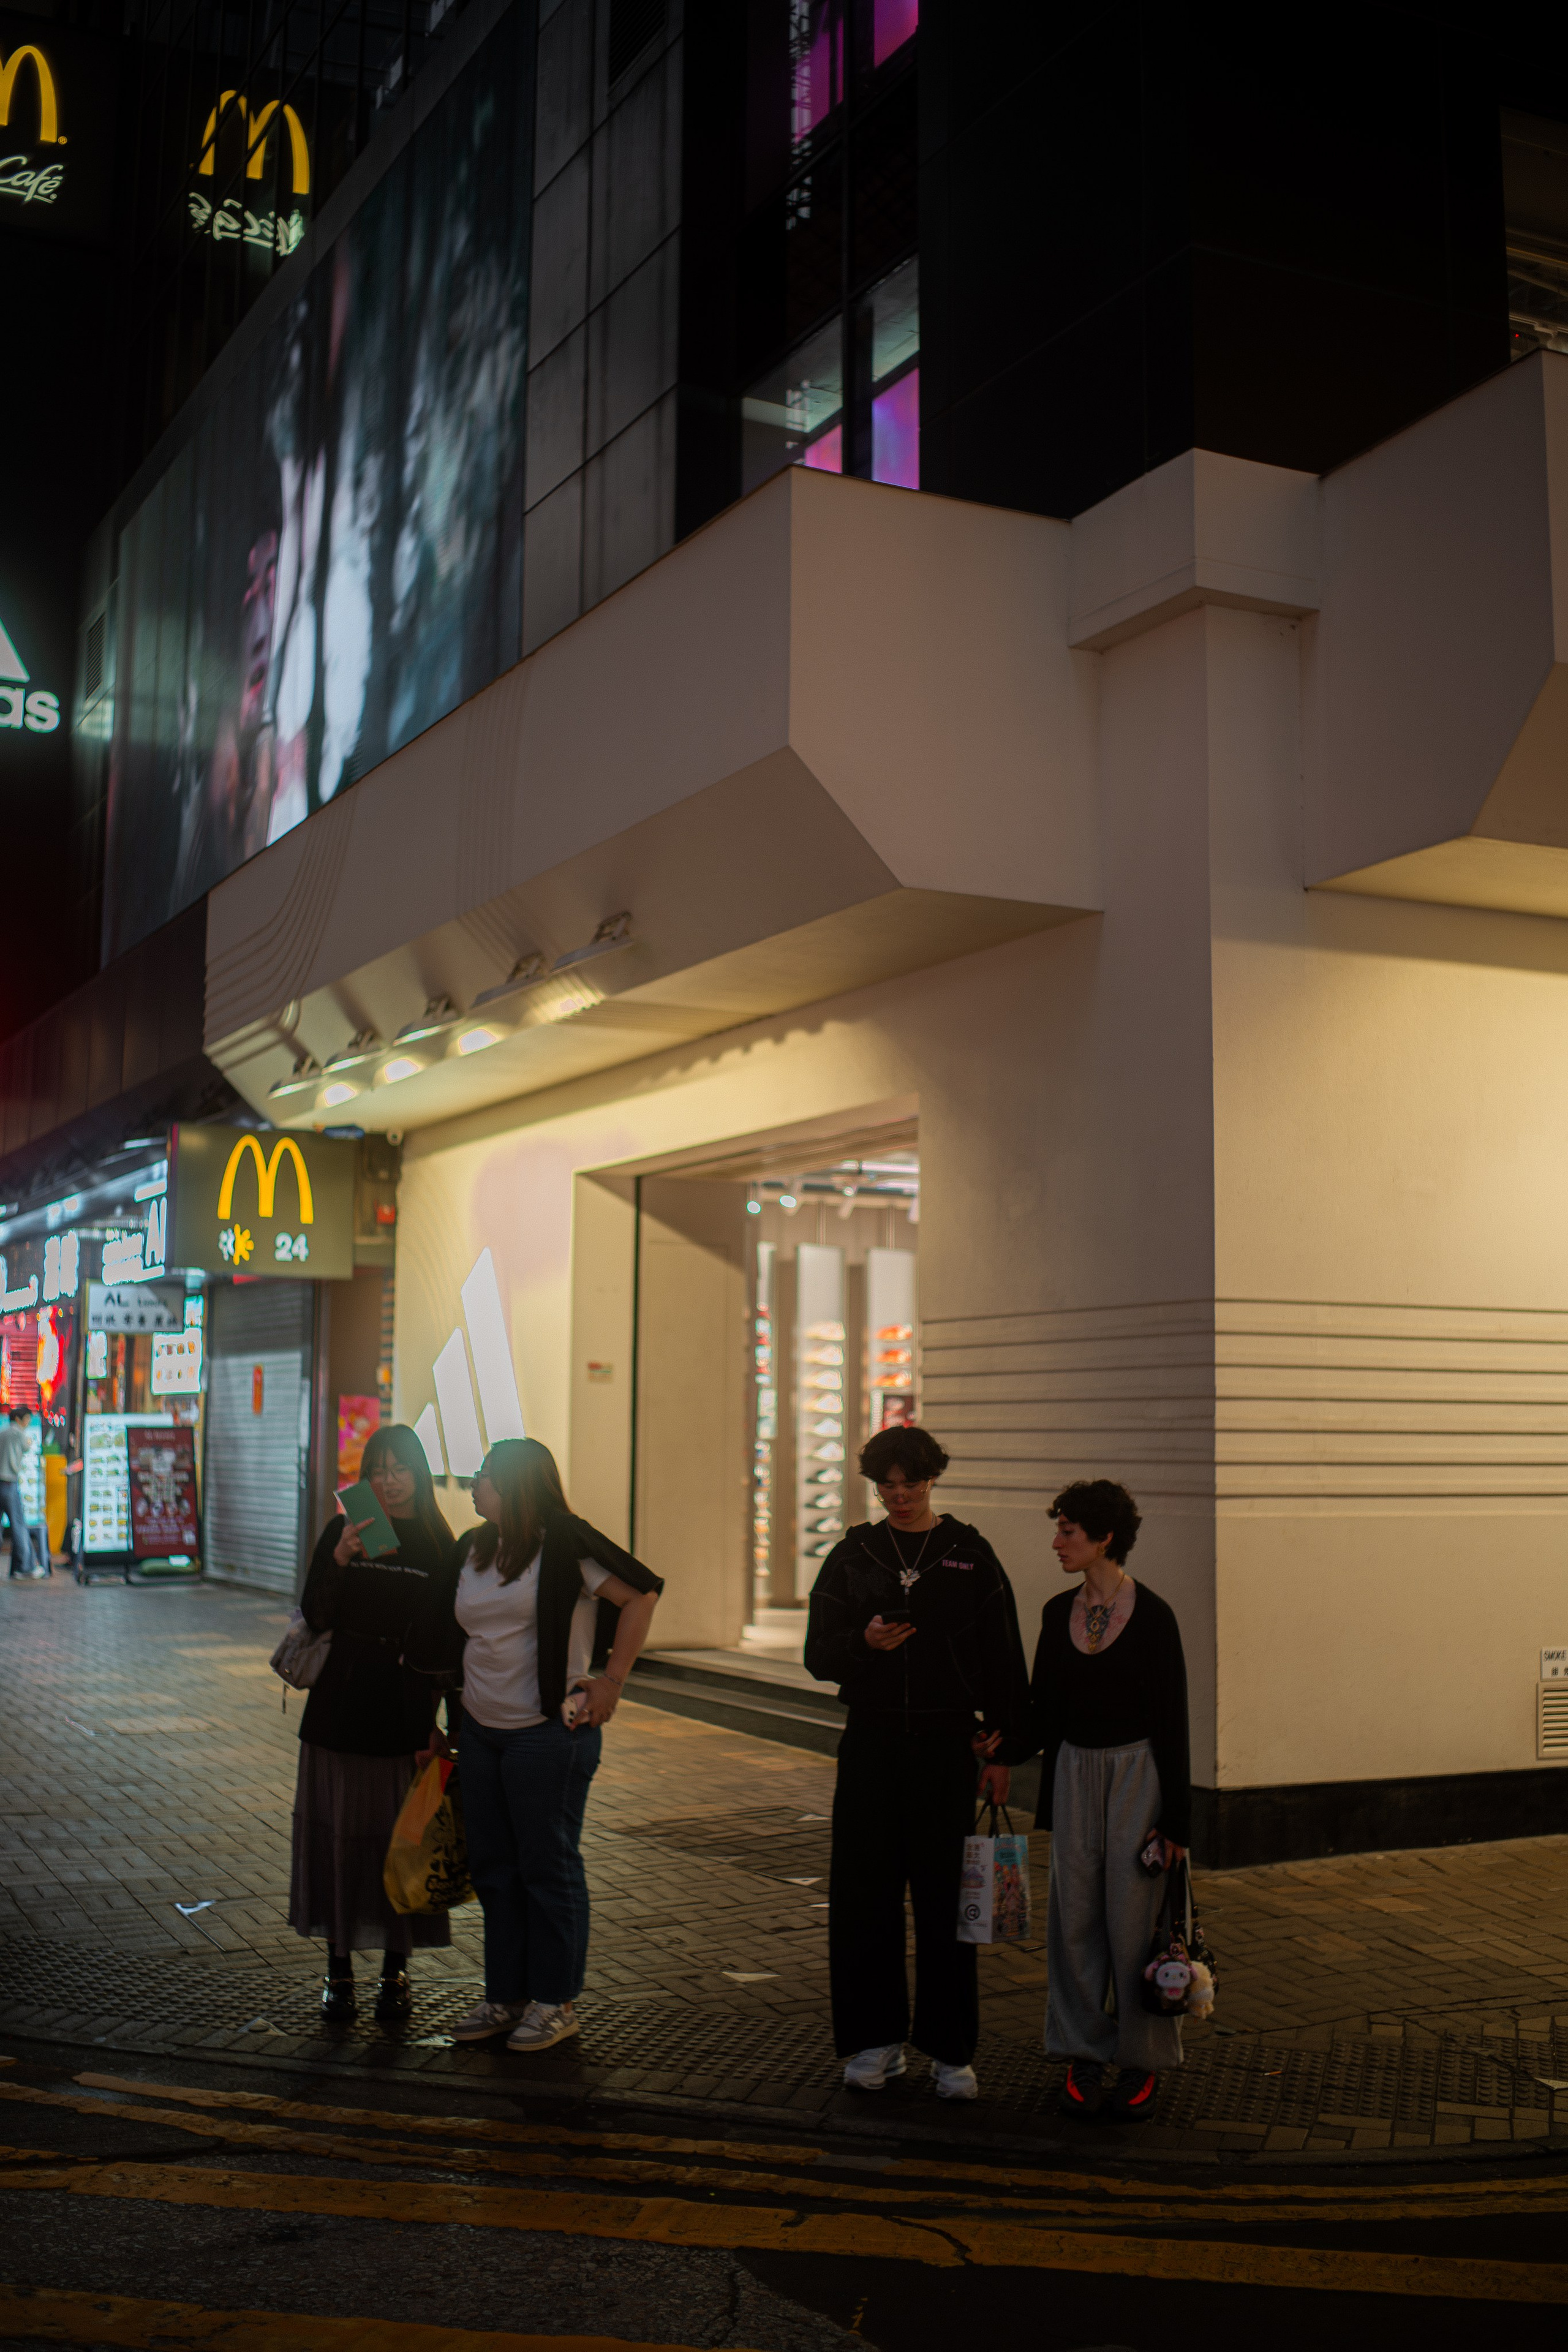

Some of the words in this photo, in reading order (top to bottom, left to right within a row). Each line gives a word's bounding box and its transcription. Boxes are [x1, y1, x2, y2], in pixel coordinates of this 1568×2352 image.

[274, 1232, 309, 1262] 24
[942, 1559, 957, 1568] TEAM
[1544, 1649, 1567, 1661] SMOKE
